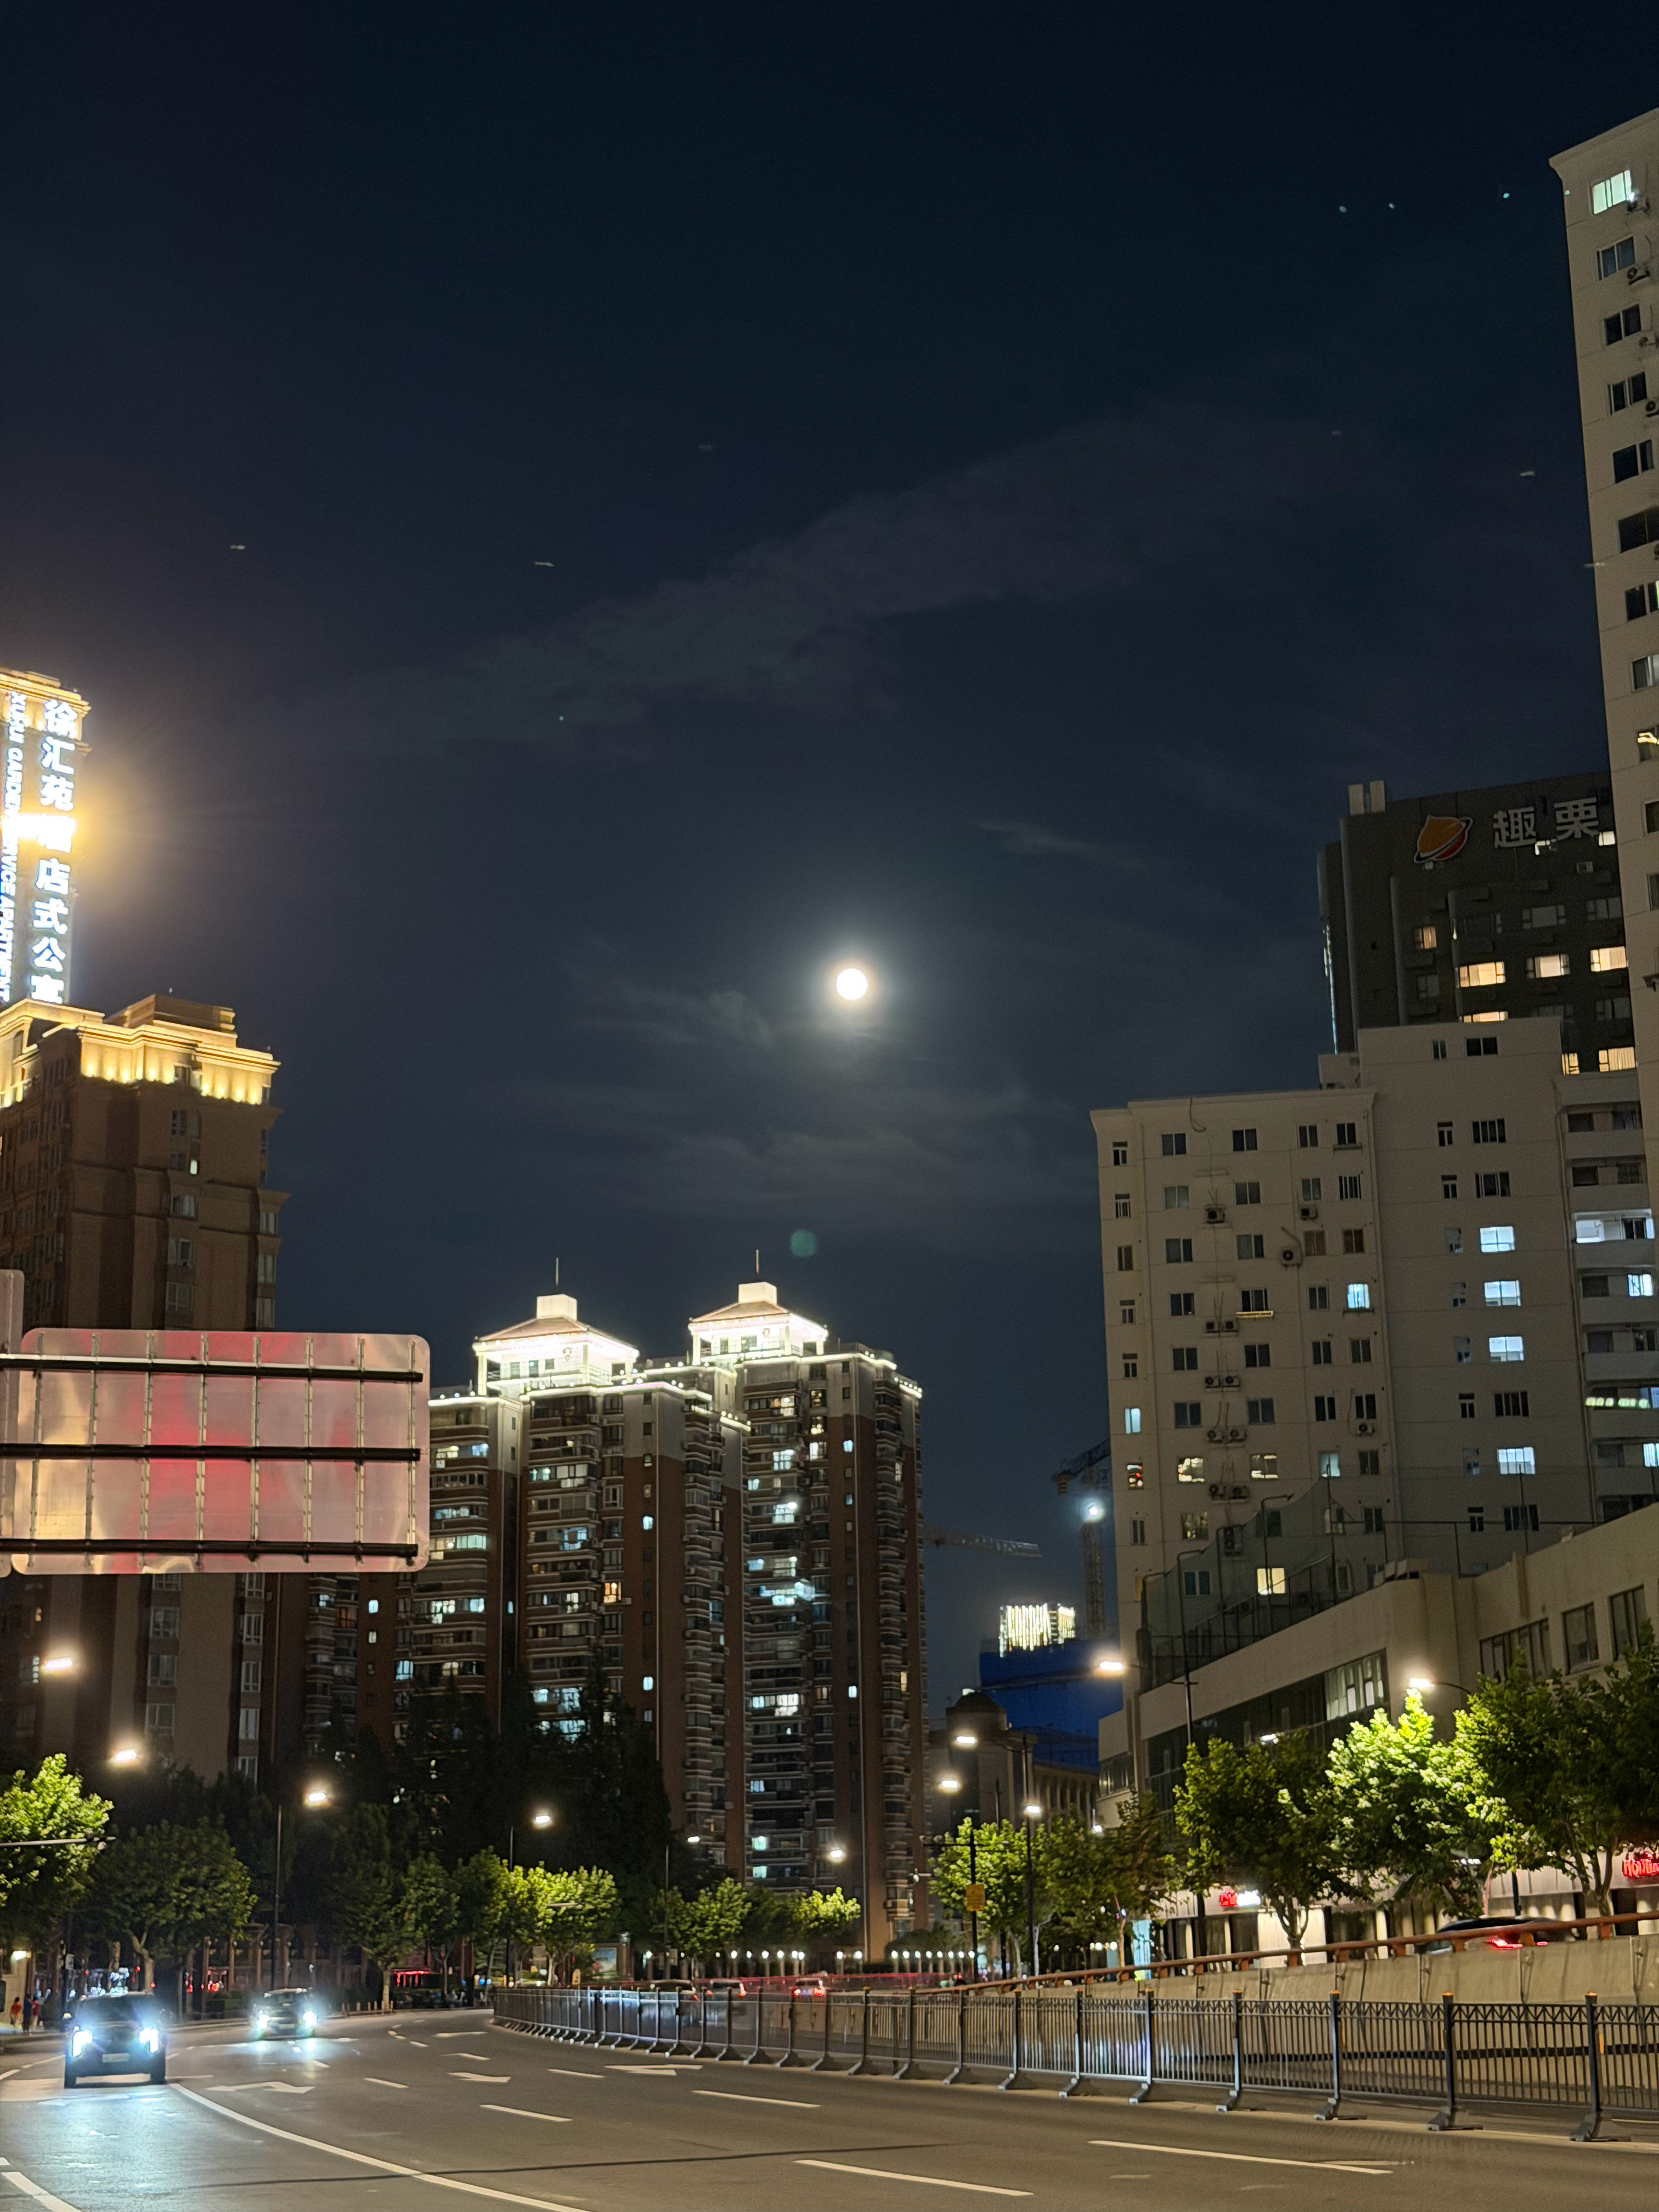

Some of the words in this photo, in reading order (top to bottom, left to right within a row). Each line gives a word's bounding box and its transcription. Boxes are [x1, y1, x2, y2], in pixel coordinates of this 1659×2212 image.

[9, 691, 26, 744] XUHUI
[31, 699, 78, 1004] 徐汇苑店式公
[1493, 797, 1600, 848] 趣栗
[0, 821, 18, 896] RVICE
